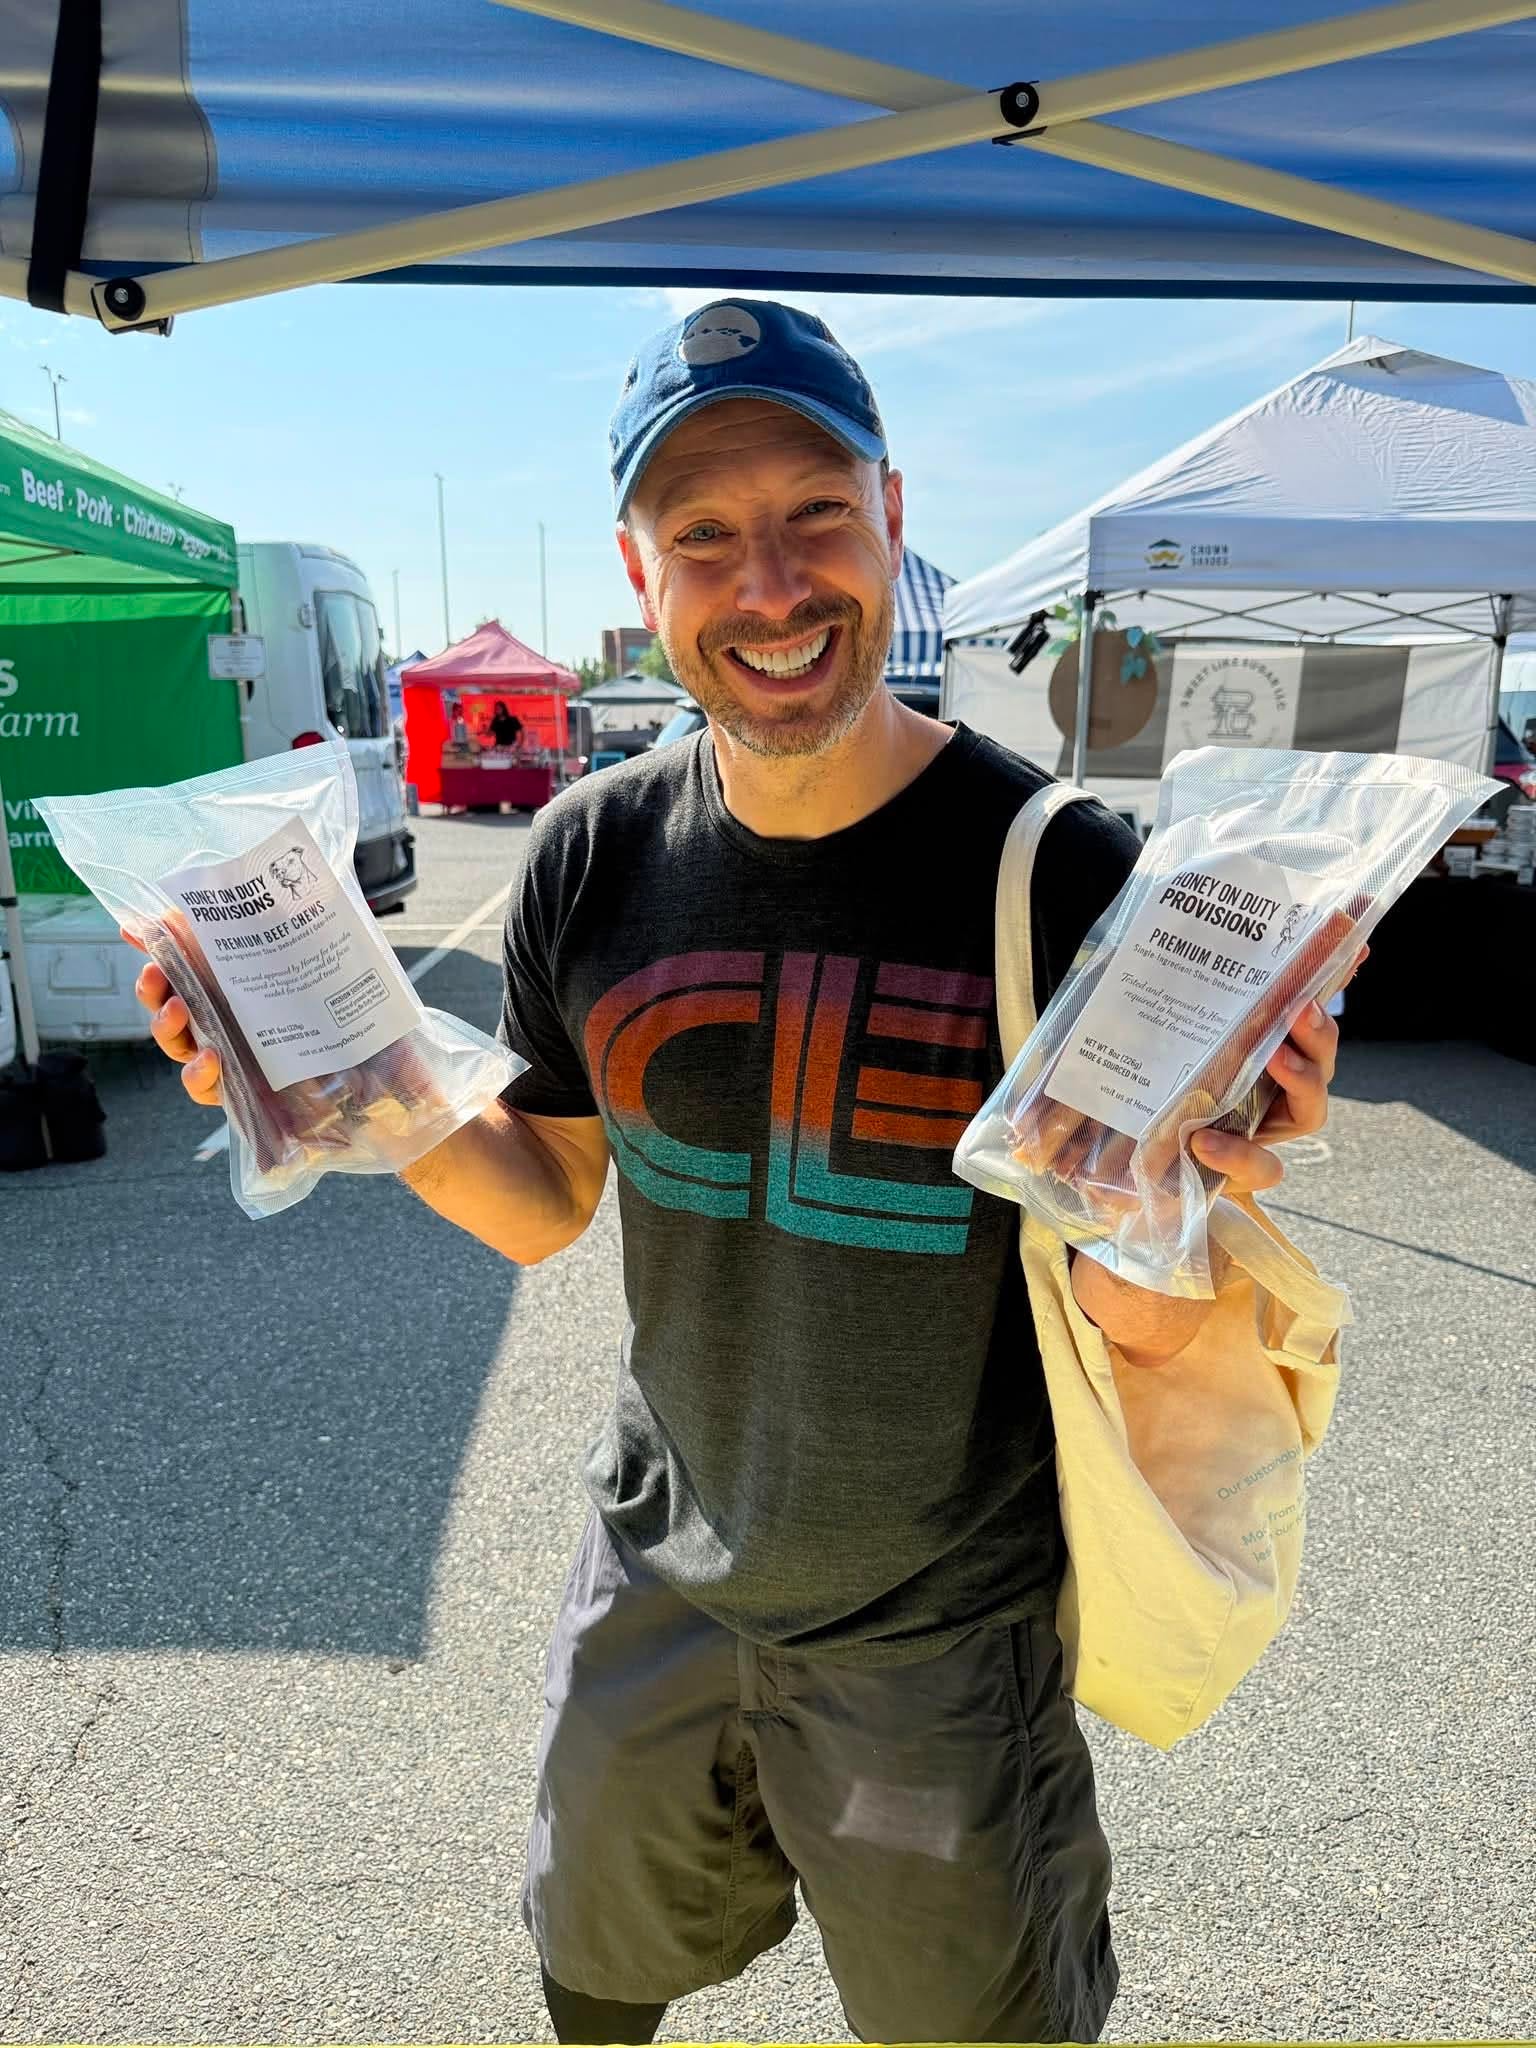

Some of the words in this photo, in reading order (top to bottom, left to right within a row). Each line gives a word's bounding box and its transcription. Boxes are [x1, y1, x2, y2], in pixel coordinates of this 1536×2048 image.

[22, 467, 64, 512] Beef
[76, 488, 113, 528] Pork
[122, 503, 177, 546] Chicken
[0, 711, 80, 738] arm
[181, 888, 219, 906] HONEY
[218, 888, 237, 905] ON
[234, 875, 266, 900] DUTY
[191, 892, 275, 922] PROVISIONS
[1171, 871, 1221, 897] HONEY
[1217, 883, 1242, 906] ON
[1238, 891, 1281, 921] DUTY
[215, 933, 264, 951] PREMIUM
[263, 922, 289, 943] BEEF
[291, 900, 325, 929] CHEWS
[1159, 887, 1267, 942] PROVISIONS
[1149, 927, 1212, 967] PREMIUM
[1211, 954, 1246, 980] BEEF
[1120, 972, 1148, 989] Tested
[1145, 984, 1165, 998] and
[1160, 992, 1200, 1013] approved
[1197, 1006, 1211, 1020] by
[1123, 990, 1159, 1009] required
[1165, 1006, 1196, 1026] hospice
[1137, 1010, 1169, 1028] needed
[1165, 1022, 1181, 1034] for
[1079, 1047, 1099, 1063] MADE
[1096, 1055, 1104, 1065] &
[1103, 1059, 1131, 1078] SOURCED
[1129, 1072, 1140, 1083] IN
[1137, 1076, 1152, 1088] USA
[1084, 1036, 1098, 1048] NET
[1107, 1047, 1122, 1060] 8oz
[1119, 1053, 1145, 1070] (226g)
[584, 950, 994, 1256] CLE
[1100, 1085, 1117, 1097] visit
[1115, 1092, 1125, 1102] us
[1124, 1097, 1135, 1106] at
[1216, 1482, 1242, 1500] Our
